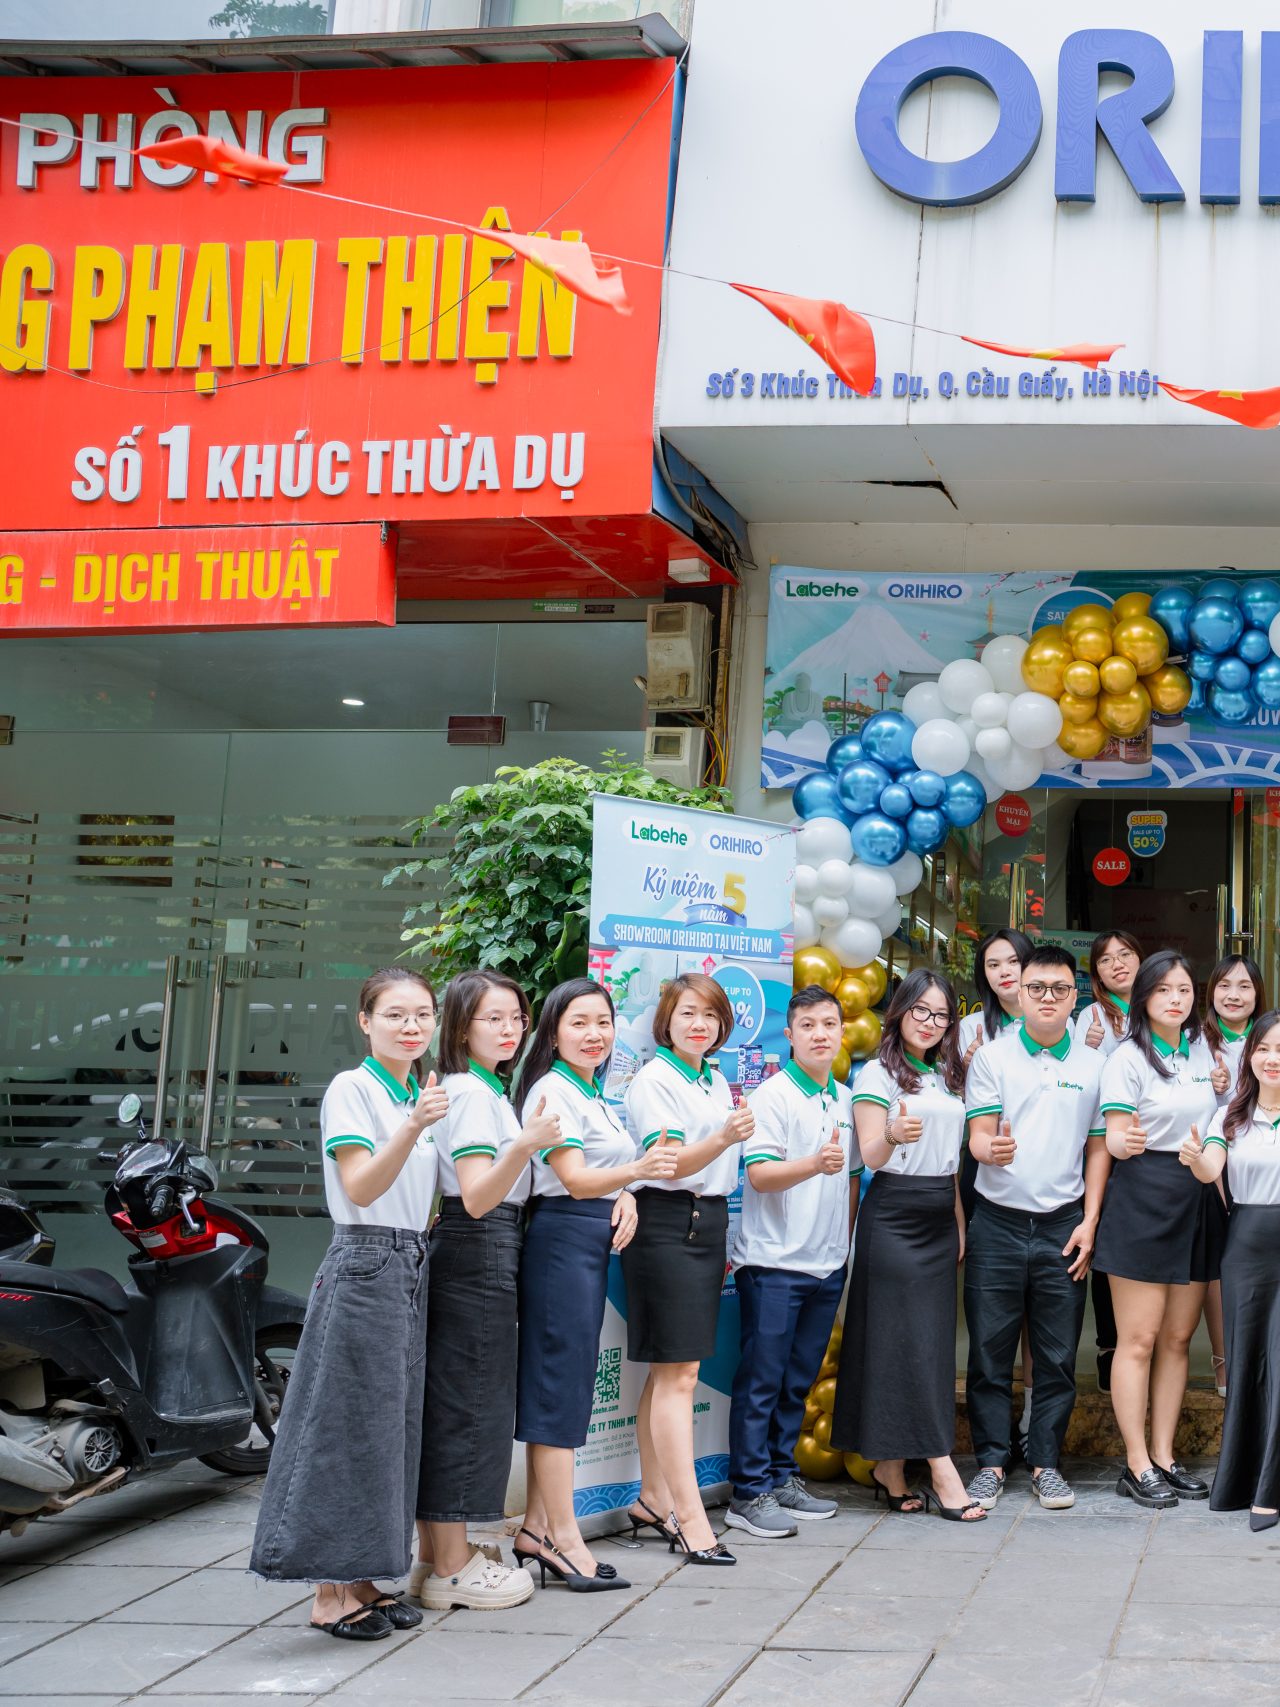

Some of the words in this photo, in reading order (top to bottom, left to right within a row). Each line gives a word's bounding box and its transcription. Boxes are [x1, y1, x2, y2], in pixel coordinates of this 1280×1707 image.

[68, 239, 317, 396] PHẠM
[336, 206, 582, 386] THIỆN
[706, 367, 739, 398] Số
[741, 373, 755, 397] 3
[760, 369, 819, 398] Khúc
[893, 372, 929, 402] Dụ,
[938, 371, 959, 399] Q.
[966, 367, 1010, 398] Cầu
[1018, 366, 1073, 401] Giấy,
[1083, 367, 1111, 397] Hà
[1119, 368, 1159, 400] Nội
[71, 425, 145, 503] SỐ
[157, 425, 191, 500] 1
[205, 429, 350, 500] KHÚC
[362, 424, 501, 496] THỪA
[512, 432, 586, 500] DỤ
[72, 552, 180, 614] DỊCH
[196, 538, 340, 609] THUẬT
[785, 580, 859, 598] Labehe
[888, 583, 962, 599] ORIHIRO
[1131, 815, 1163, 825] SUPER
[631, 820, 688, 846] Labehe
[1133, 836, 1159, 849] 50%
[709, 834, 763, 856] ORIHIRO
[1097, 861, 1126, 870] SALE
[643, 866, 667, 900] Kỷ
[670, 872, 717, 904] niệm
[721, 872, 747, 916] 5
[699, 905, 728, 923] năm
[613, 923, 671, 944] SHOWROOM
[672, 929, 714, 948] ORIHIRO
[714, 933, 729, 952] TẠI
[730, 931, 750, 954] VIỆT
[751, 937, 772, 953] NAM
[730, 987, 740, 995] UP
[741, 987, 752, 996] TO
[1057, 1079, 1084, 1092] Labehe
[598, 1421, 606, 1432] TY
[608, 1418, 626, 1430] TNHH
